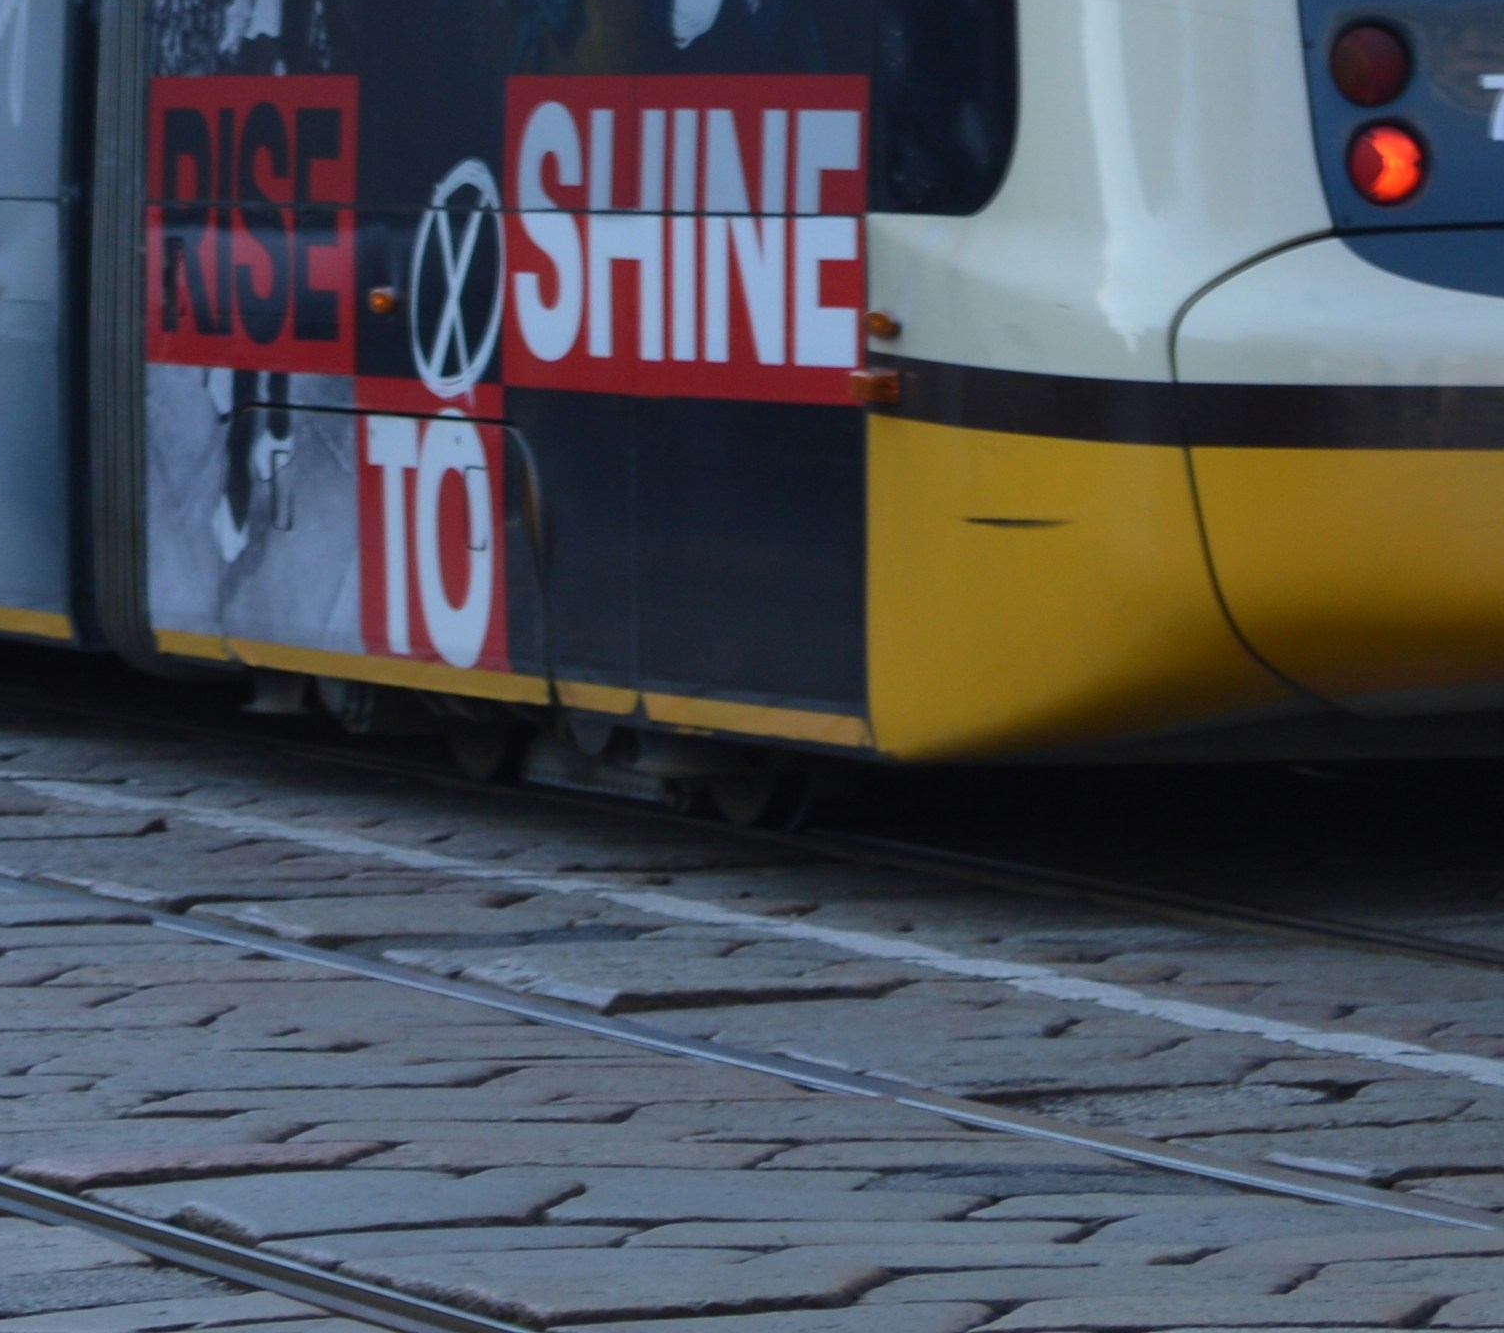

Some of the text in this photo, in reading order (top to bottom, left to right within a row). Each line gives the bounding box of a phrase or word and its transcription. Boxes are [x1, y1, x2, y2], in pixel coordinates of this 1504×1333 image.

[162, 101, 343, 345] RISE
[514, 101, 861, 369] SHINE
[366, 407, 493, 669] TO
